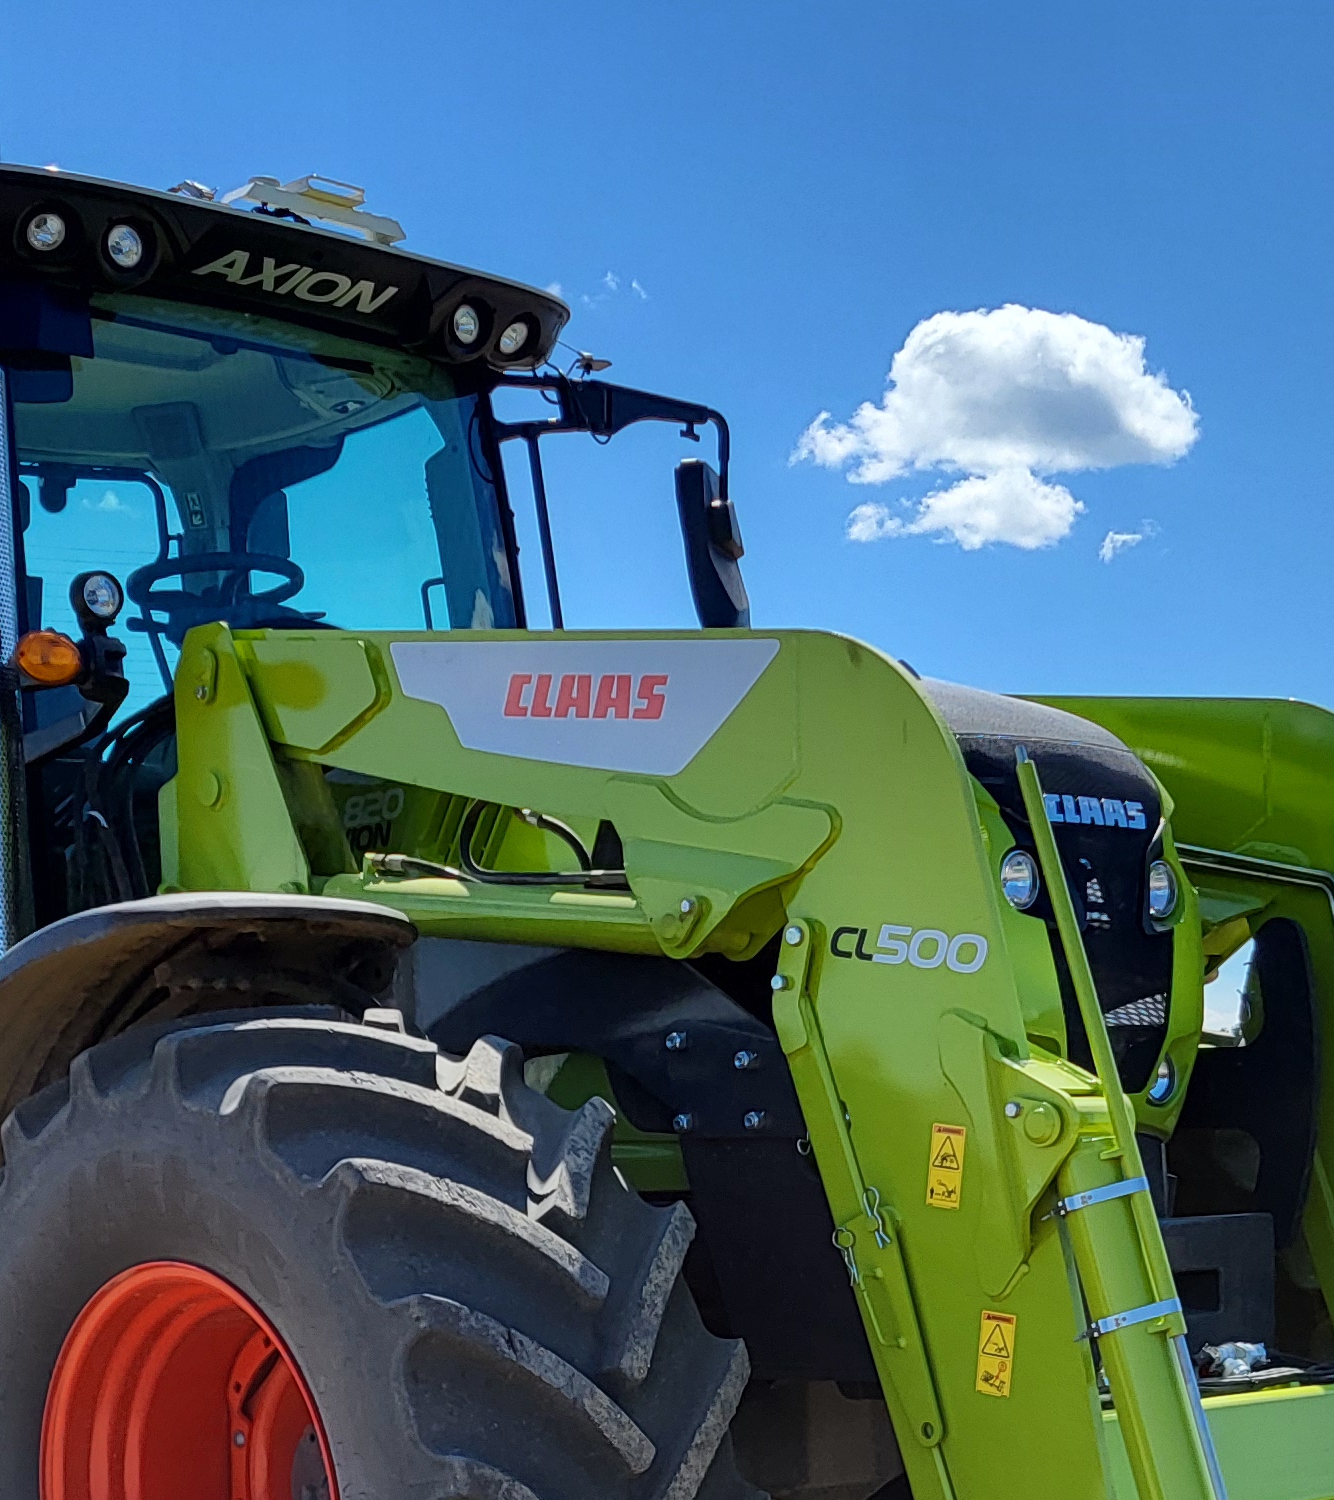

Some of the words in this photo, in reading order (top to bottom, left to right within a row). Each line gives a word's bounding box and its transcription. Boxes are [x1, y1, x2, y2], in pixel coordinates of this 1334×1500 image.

[191, 249, 399, 314] AXION
[503, 673, 668, 719] CLAAS
[344, 787, 405, 828] 820
[1043, 793, 1147, 830] CLAAS
[830, 923, 988, 974] CL500
